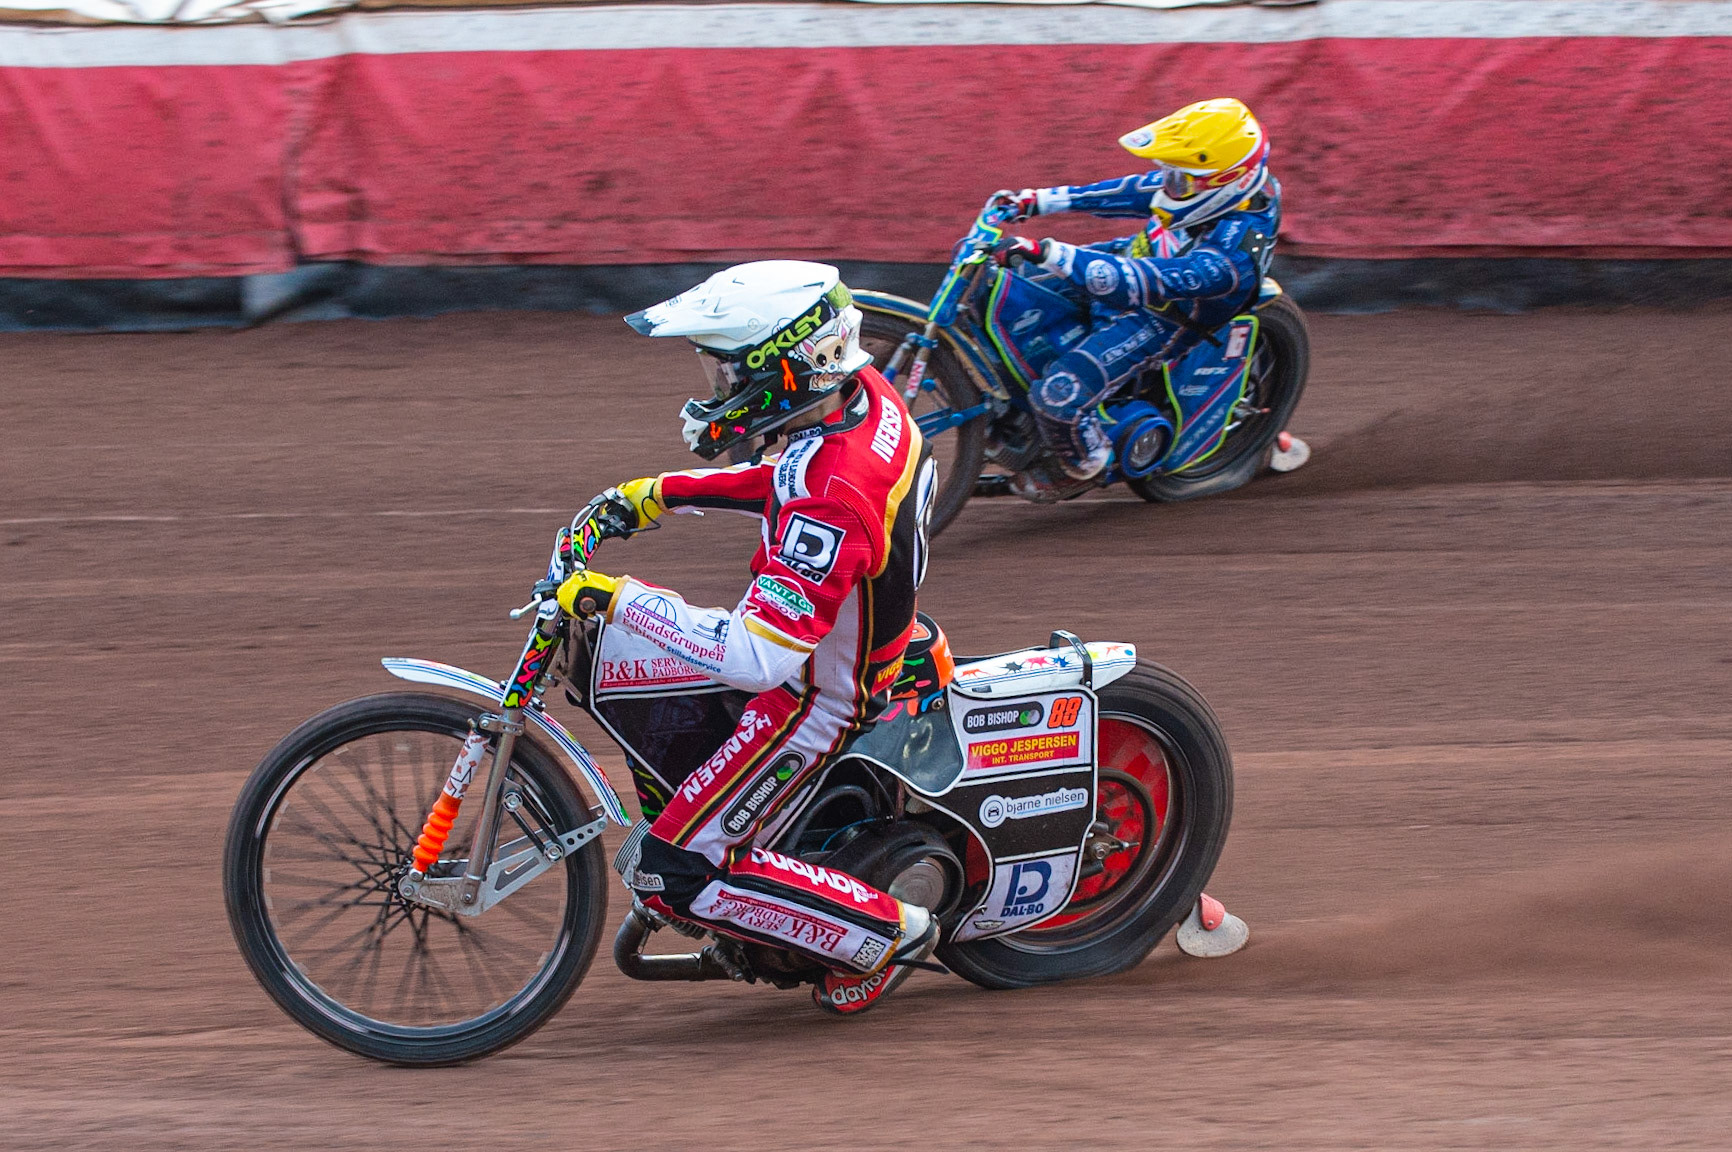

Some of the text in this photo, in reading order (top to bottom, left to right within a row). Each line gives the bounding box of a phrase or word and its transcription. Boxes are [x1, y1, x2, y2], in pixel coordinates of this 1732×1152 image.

[746, 305, 823, 369] OAKLEY
[759, 577, 815, 613] VANTAGE
[623, 606, 725, 662] StilladsGruppen
[602, 659, 648, 681] B&K
[967, 710, 1020, 728] BOB BISHOP
[1047, 697, 1082, 729] 88
[682, 713, 772, 803] HANSEN
[971, 733, 1077, 757] VIGGO JESPERSEN
[992, 750, 1055, 765] INT. TRANSPORT
[728, 776, 778, 832] BOB BISHOP
[1006, 790, 1085, 815] bjarne nielsen
[721, 905, 780, 932] SERVICE
[725, 900, 793, 923] PADBORG
[1000, 902, 1044, 918] DAL-BO
[782, 918, 842, 953] B&K
